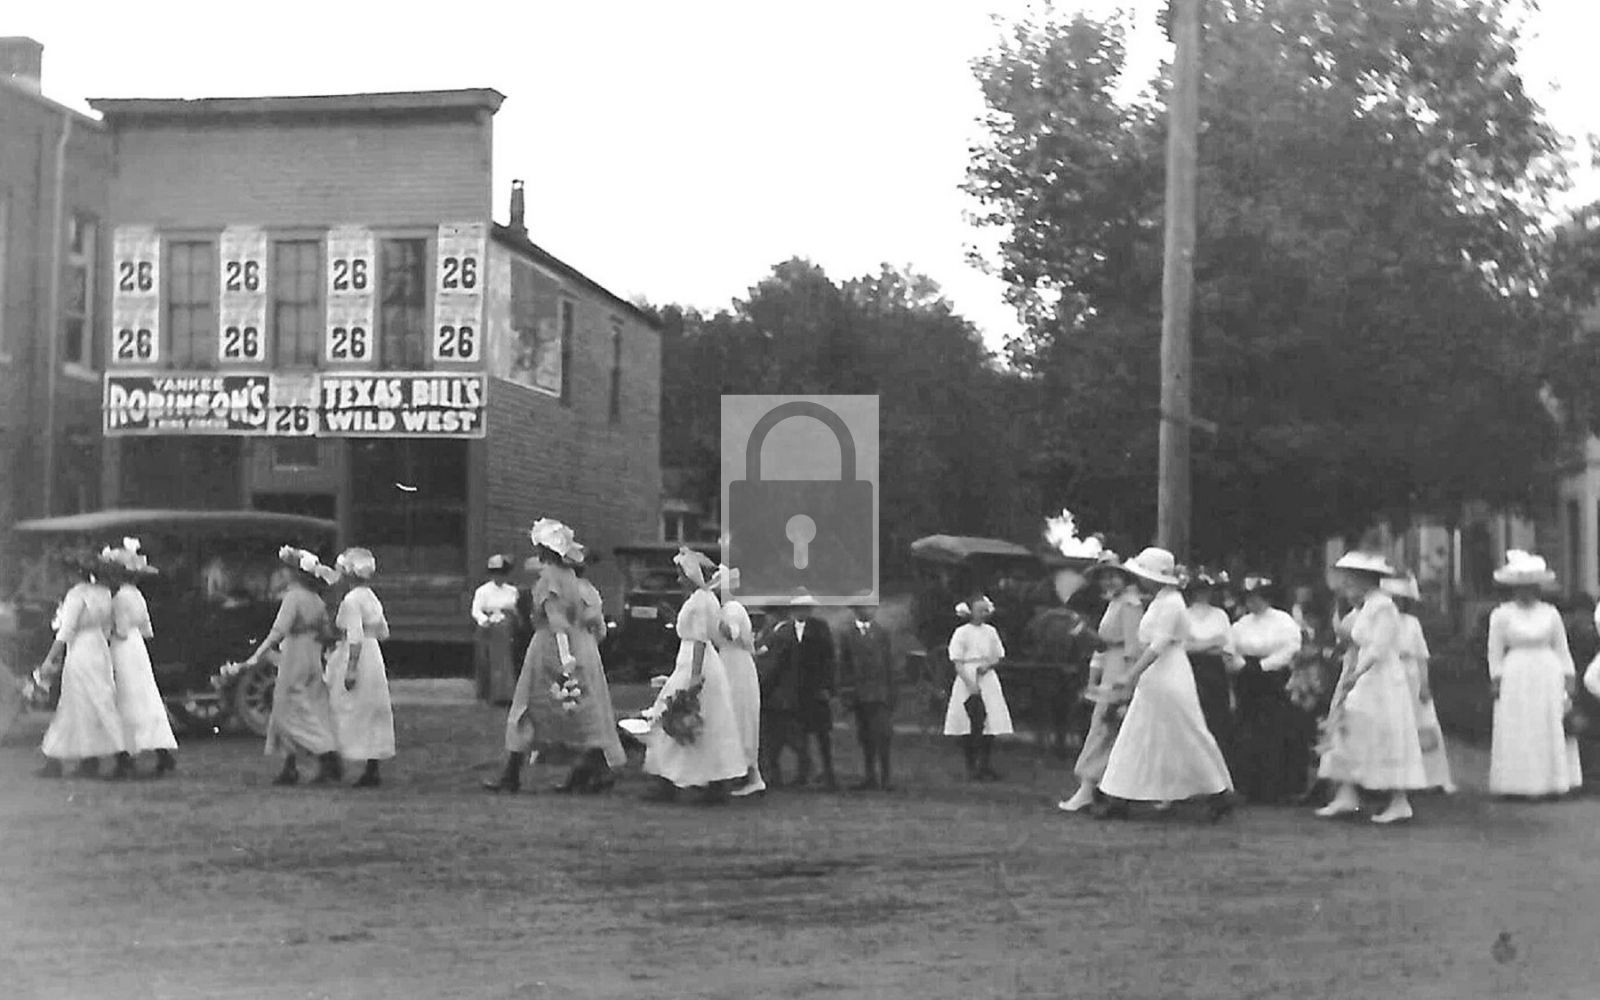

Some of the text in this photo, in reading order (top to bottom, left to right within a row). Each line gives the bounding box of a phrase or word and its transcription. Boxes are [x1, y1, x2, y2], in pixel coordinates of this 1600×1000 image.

[119, 261, 152, 291] 26
[226, 260, 259, 291] 26
[333, 259, 367, 290] 26
[443, 257, 476, 288] 26
[118, 328, 152, 358] 26
[225, 326, 258, 358] 26
[332, 326, 366, 358] 26
[439, 325, 473, 358] 26
[152, 378, 224, 391] YANKEE
[109, 379, 265, 427] ROBINSON'S
[276, 406, 309, 431] 26
[326, 410, 477, 432] WILD WEST
